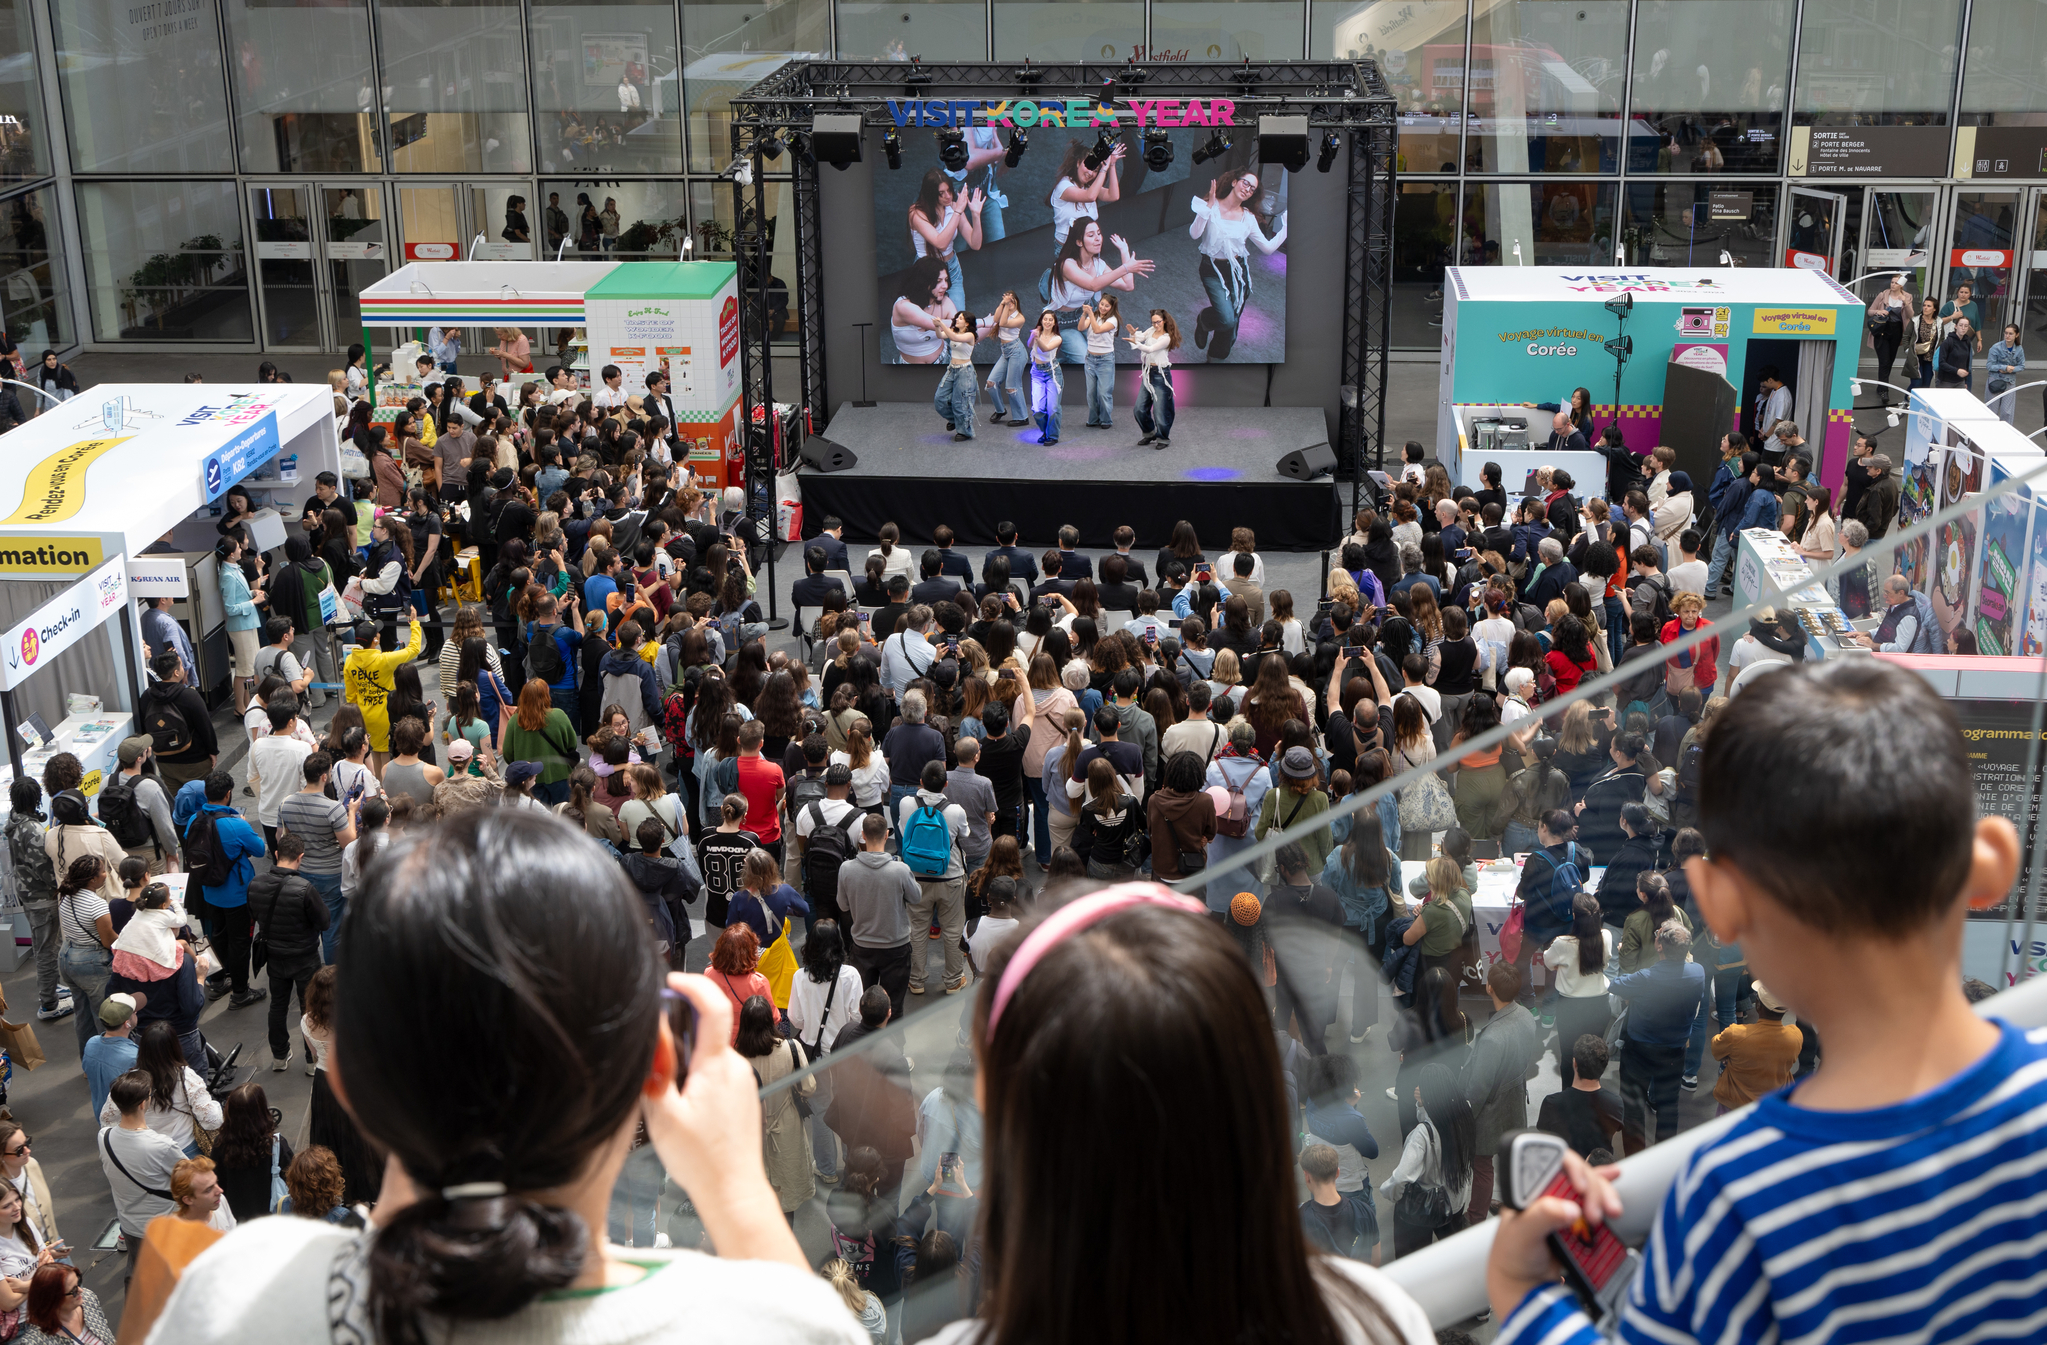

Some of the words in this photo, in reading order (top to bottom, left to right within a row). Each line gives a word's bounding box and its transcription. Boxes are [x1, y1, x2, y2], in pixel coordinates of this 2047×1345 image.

[129, 4, 156, 25] OUVERT
[158, 3, 163, 18] 7
[165, 0, 186, 17] JOURS
[142, 26, 158, 41] OPEN
[163, 21, 178, 36] DAYS
[183, 17, 199, 32] WEEK
[886, 100, 981, 128] VISIT
[986, 100, 1120, 128] KOREA
[1126, 100, 1235, 128] YEAR
[1548, 113, 1557, 122] -3
[1590, 280, 1727, 289] KOREA
[1761, 313, 1791, 322] Voyage
[1791, 311, 1817, 321] virtuel
[1778, 321, 1811, 331] Corée
[721, 325, 737, 348] WONDER
[1498, 328, 1545, 343] Voyage
[1545, 325, 1588, 340] virtuel
[1587, 332, 1605, 344] en
[722, 336, 738, 359] K-FOOD
[1526, 341, 1578, 357] Corée
[175, 405, 222, 426] VISIT
[209, 392, 266, 421] KOREA
[224, 404, 274, 426] YEAR
[232, 456, 246, 476] K82
[25, 472, 67, 521] Rendez-vous
[58, 441, 105, 464] Corée
[98, 575, 112, 591] VISIT
[103, 579, 123, 598] KOREA
[100, 592, 117, 609] YEAR
[41, 608, 81, 644] Check-in
[84, 775, 100, 791] Corée
[1980, 783, 1994, 791] DE
